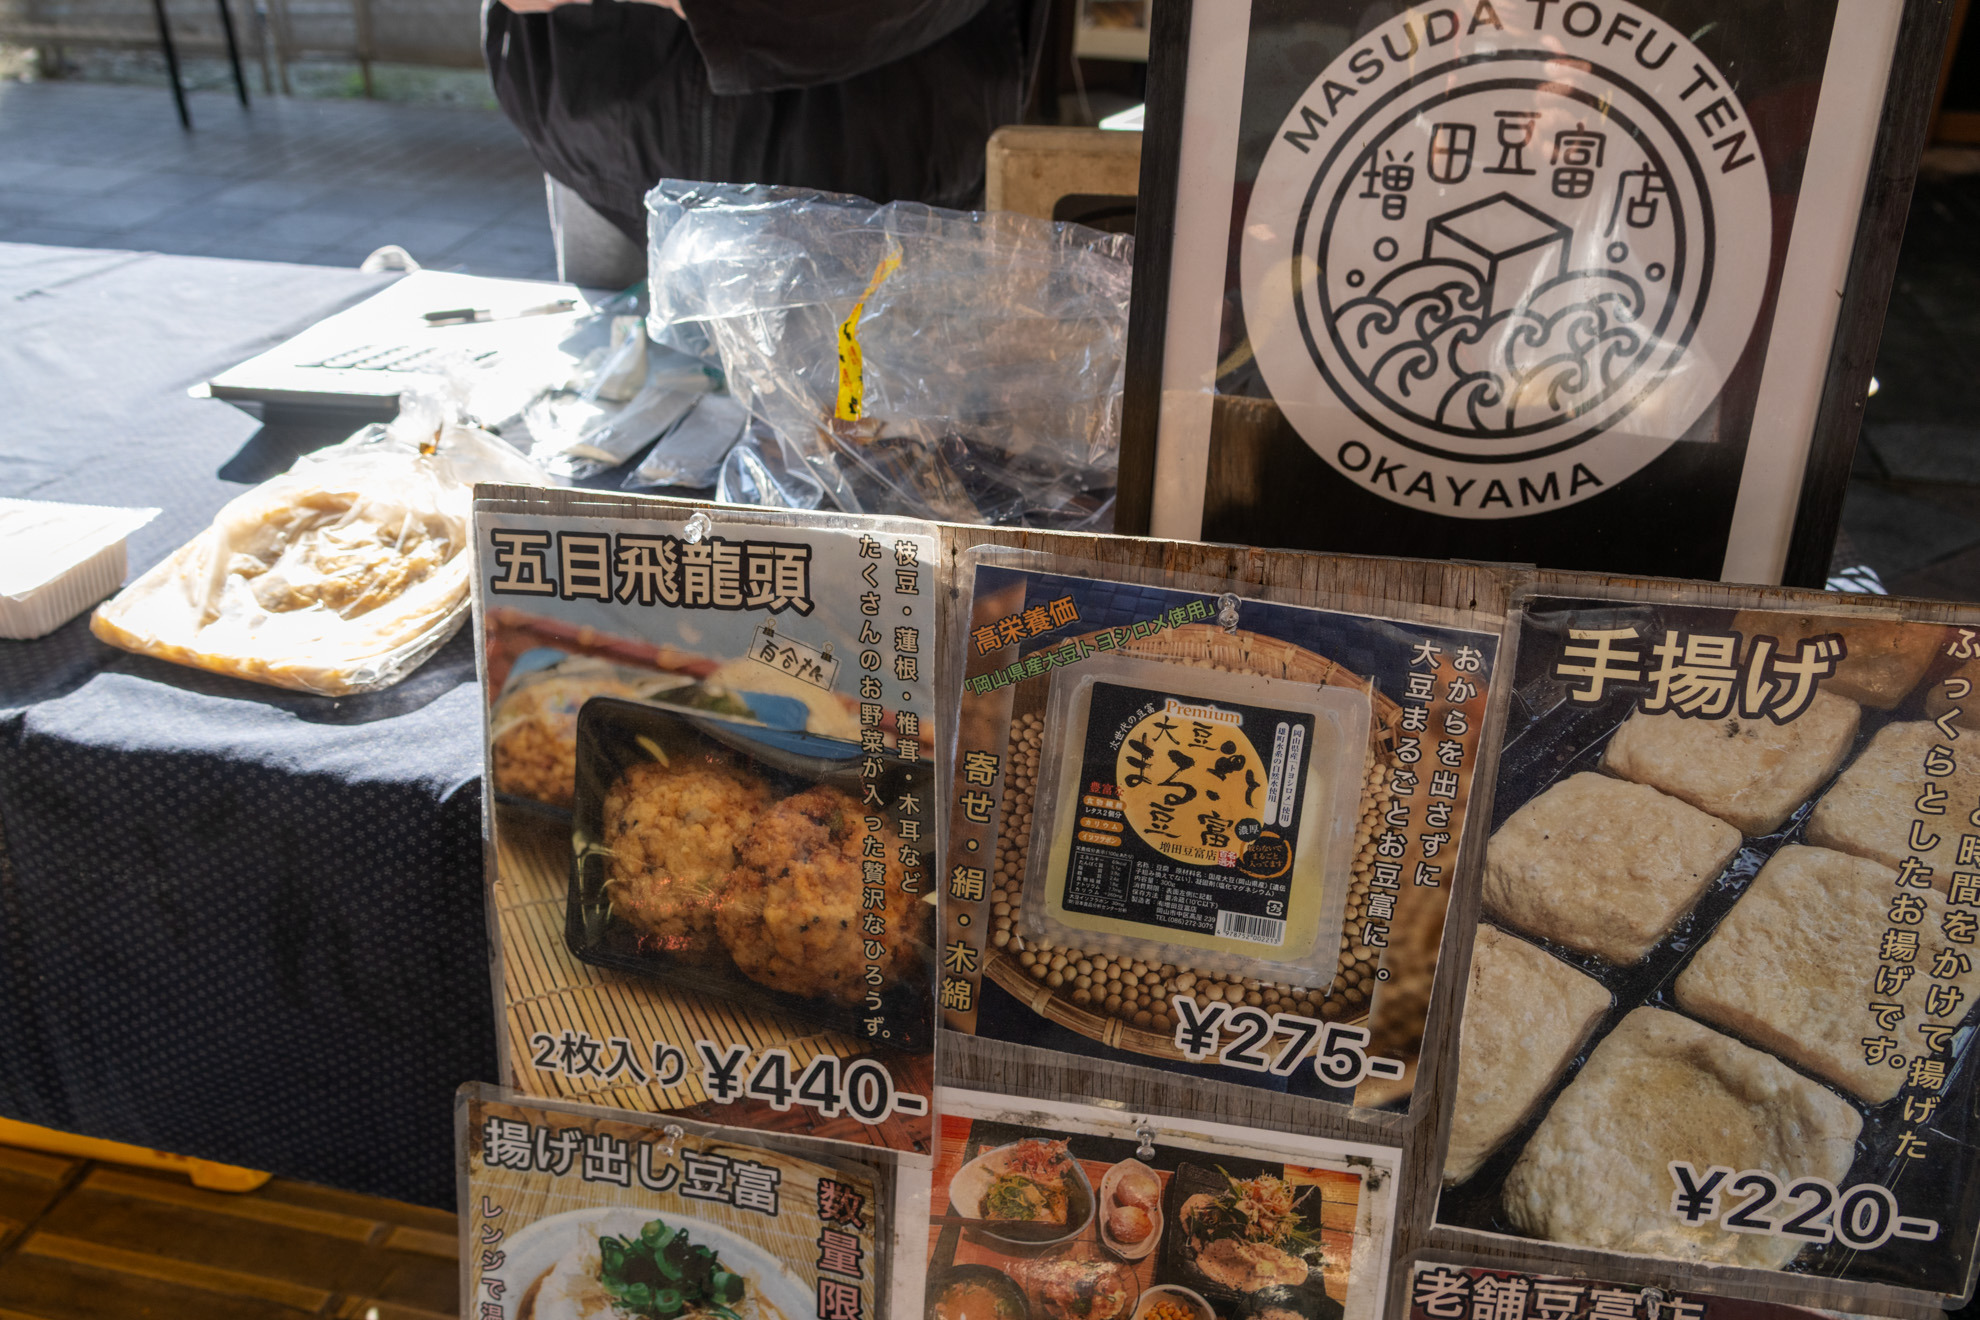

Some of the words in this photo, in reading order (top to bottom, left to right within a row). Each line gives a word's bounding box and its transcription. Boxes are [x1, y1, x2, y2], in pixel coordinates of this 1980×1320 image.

[1283, 0, 1504, 154] MASUDA
[1525, 0, 1678, 70] TOFU
[1679, 64, 1757, 174] TEN
[1358, 110, 1667, 237] 増田豆富店
[1336, 440, 1604, 509] OKAYAMA
[491, 528, 815, 616] 五目飛龍頭
[963, 598, 1216, 696] 「岡山県産大豆トヨシロメ使用」
[970, 594, 1081, 656] 高栄養価
[895, 540, 922, 894] 枝豆・蓮根・椎茸・木耳など
[1165, 699, 1241, 724] Premium
[1554, 626, 1847, 726] 手揚げ
[1152, 715, 1218, 751] 大豆
[1414, 643, 1484, 889] おからを出さずに
[859, 534, 891, 1040] たくさんのお野菜が入った贅沢なひろうず。
[1361, 639, 1443, 982] 大豆まるごとお豆富に。
[940, 751, 1000, 1013] 寄せ・絹・木綿
[1159, 841, 1218, 861] 増田豆富店
[1861, 627, 1980, 1070] ふっくらとしたお揚げです。
[532, 1030, 688, 1088] 2枚入り
[697, 1040, 929, 1124] ¥440-
[1173, 995, 1405, 1088] ¥275-
[482, 1116, 782, 1217] 揚げ出し豆富
[1667, 1160, 1940, 1250] ¥220-
[817, 1177, 866, 1320] 数量限
